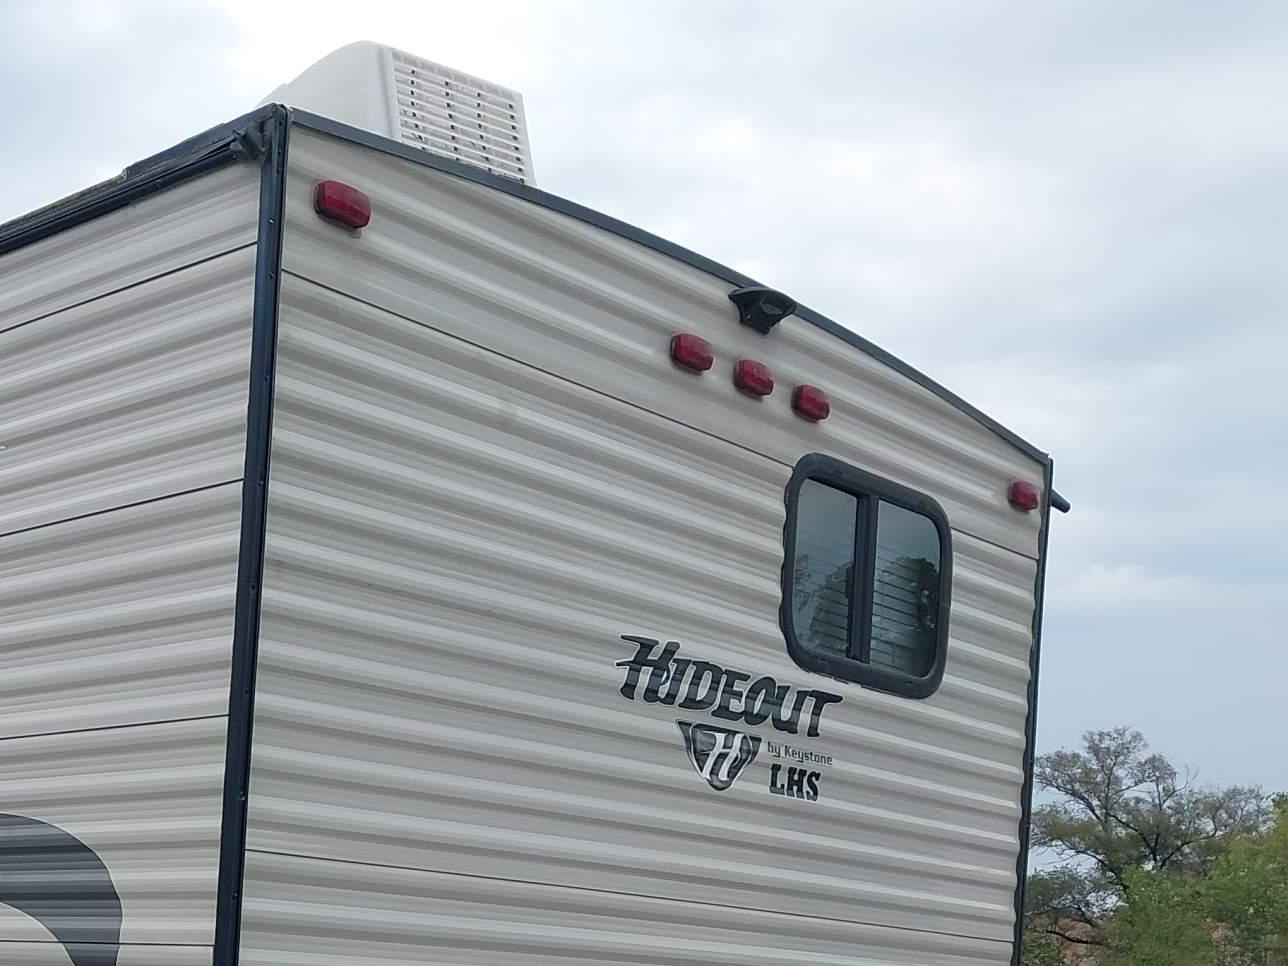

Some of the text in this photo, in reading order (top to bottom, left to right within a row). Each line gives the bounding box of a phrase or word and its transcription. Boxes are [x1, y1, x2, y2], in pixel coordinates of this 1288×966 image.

[615, 635, 844, 737] HIDEOUT
[767, 742, 833, 765] by Keystone
[769, 764, 821, 802] LHS
